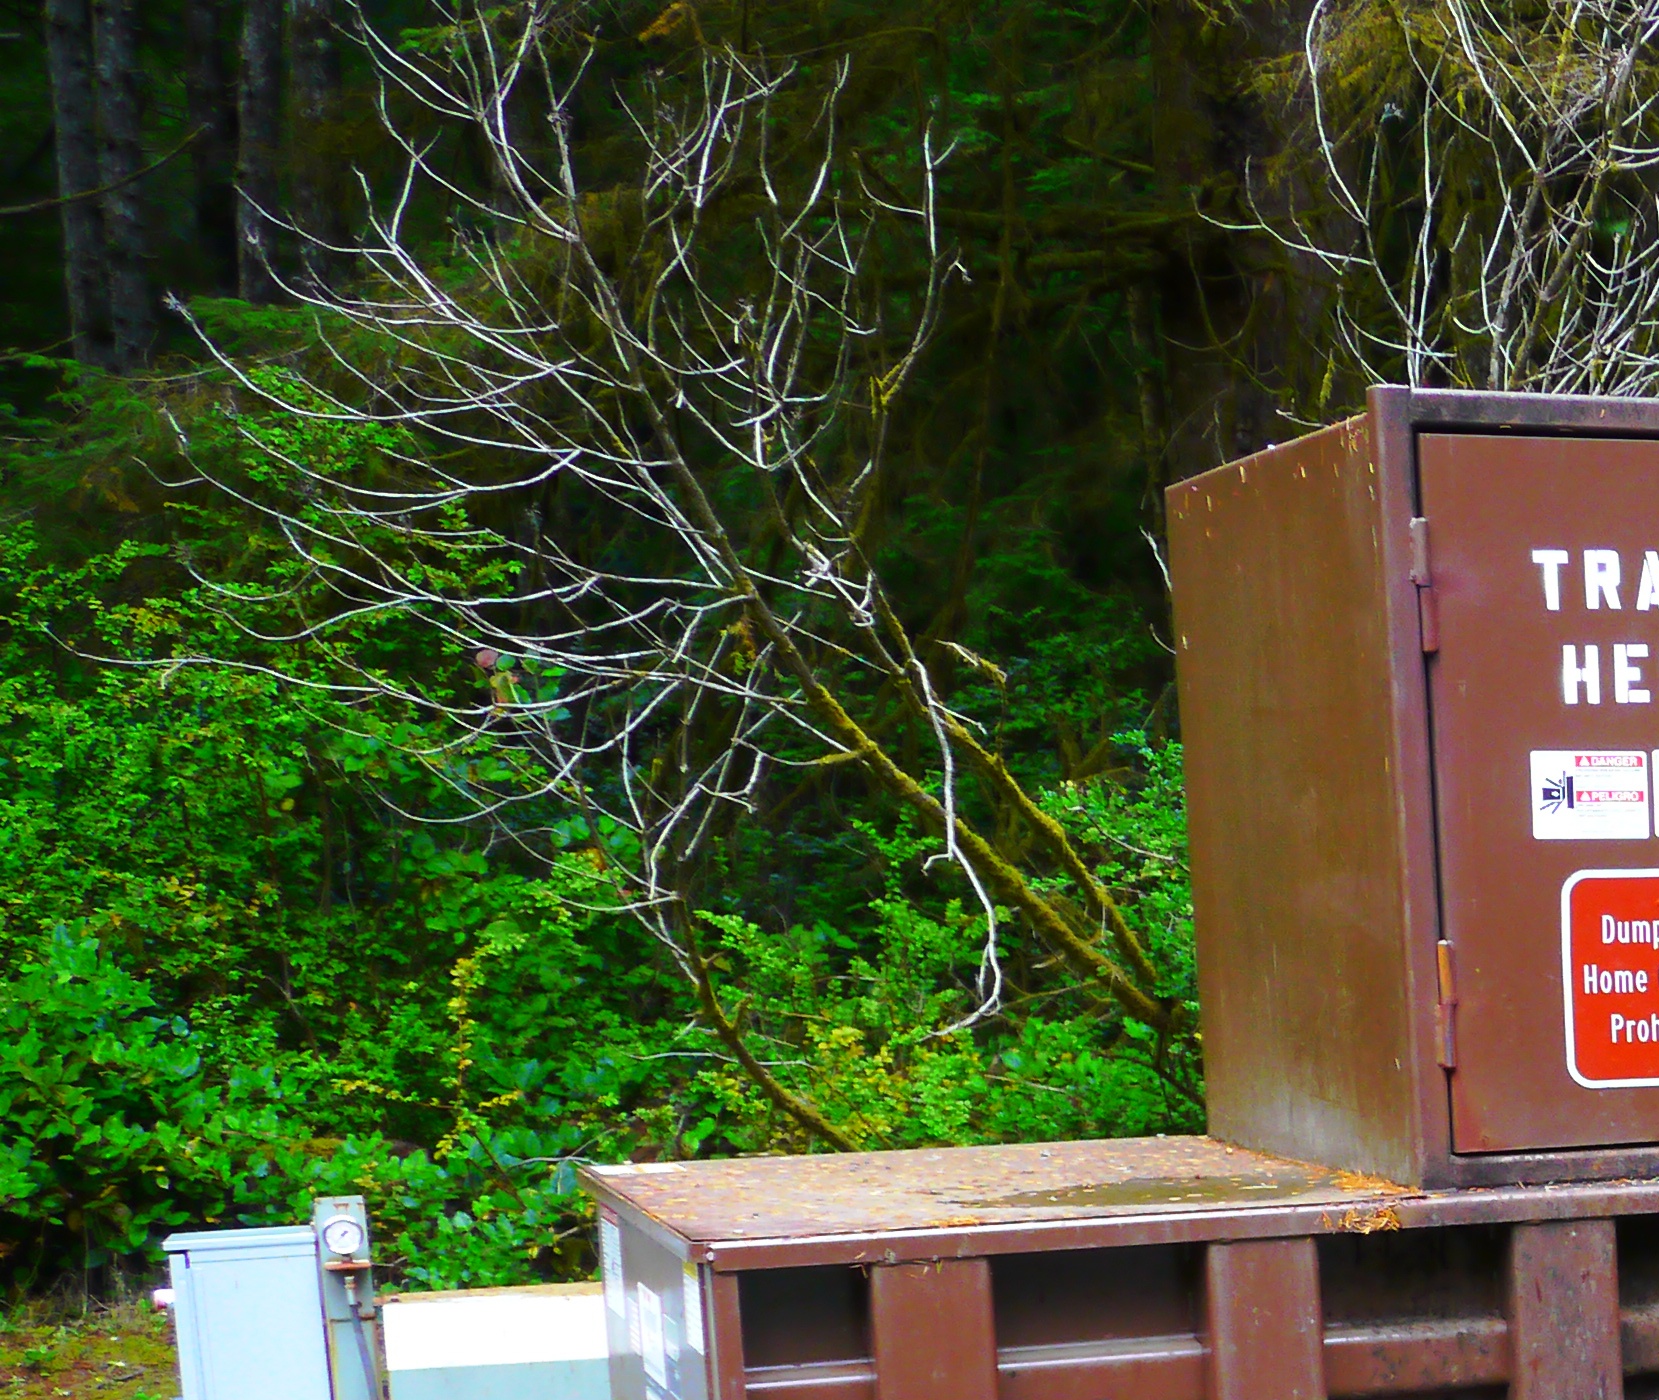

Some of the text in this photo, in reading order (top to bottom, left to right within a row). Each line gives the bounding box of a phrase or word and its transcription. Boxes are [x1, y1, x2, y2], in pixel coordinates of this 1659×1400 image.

[1590, 756, 1638, 767] DANGER
[1591, 792, 1639, 802] PELIGRO
[1583, 963, 1648, 994] Home
